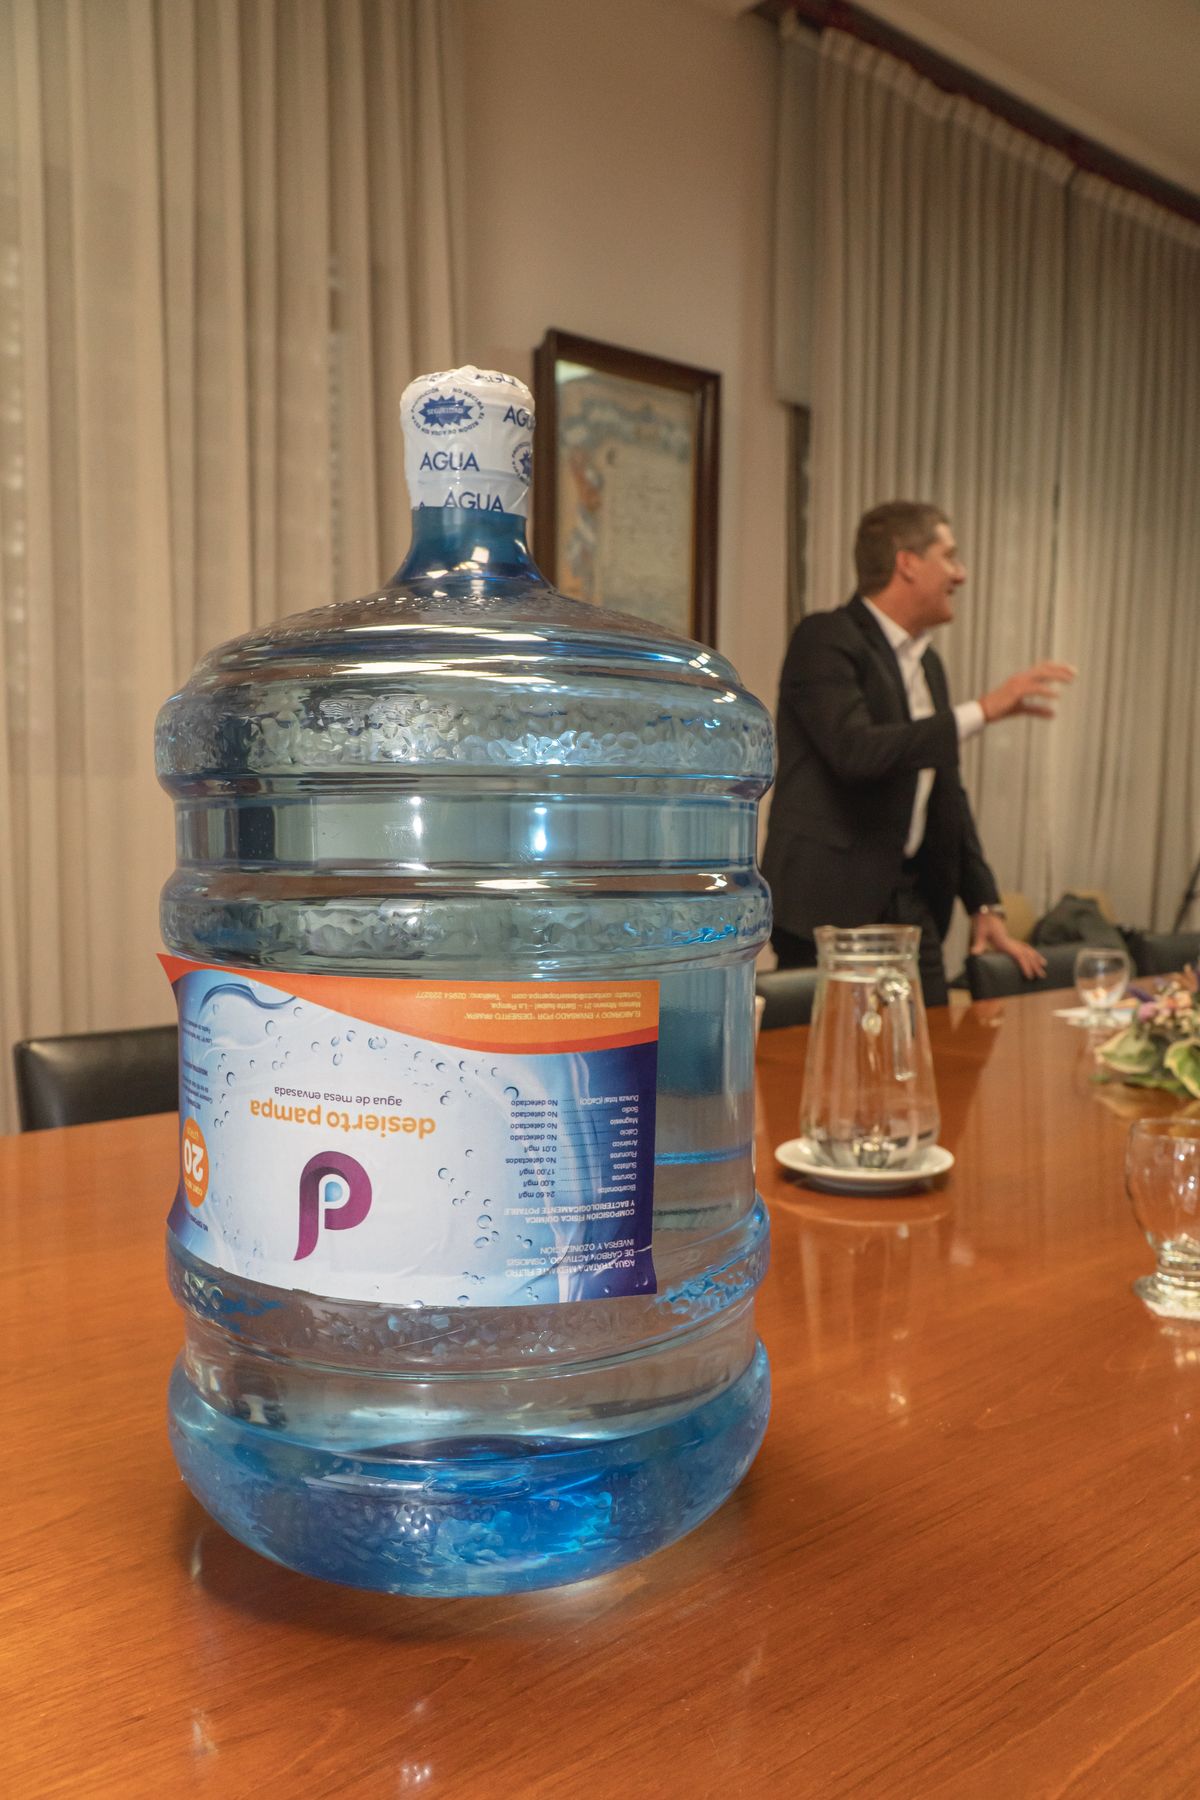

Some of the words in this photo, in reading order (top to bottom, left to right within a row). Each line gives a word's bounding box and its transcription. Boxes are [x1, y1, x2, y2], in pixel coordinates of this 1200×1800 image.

[420, 452, 480, 471] AGUA
[444, 491, 504, 512] AGUA
[274, 1086, 321, 1099] envasada
[323, 1091, 352, 1103] mesa
[355, 1095, 373, 1105] de
[373, 1095, 402, 1106] agua
[250, 1097, 322, 1125] pampa
[327, 1111, 436, 1139] desierto
[184, 1138, 204, 1182] 20
[504, 1207, 541, 1216] POTABLE
[603, 1239, 634, 1249] INVERSA
[624, 1248, 634, 1257] DE
[579, 1261, 612, 1272] TRATADA
[615, 1259, 635, 1268] AGUA
